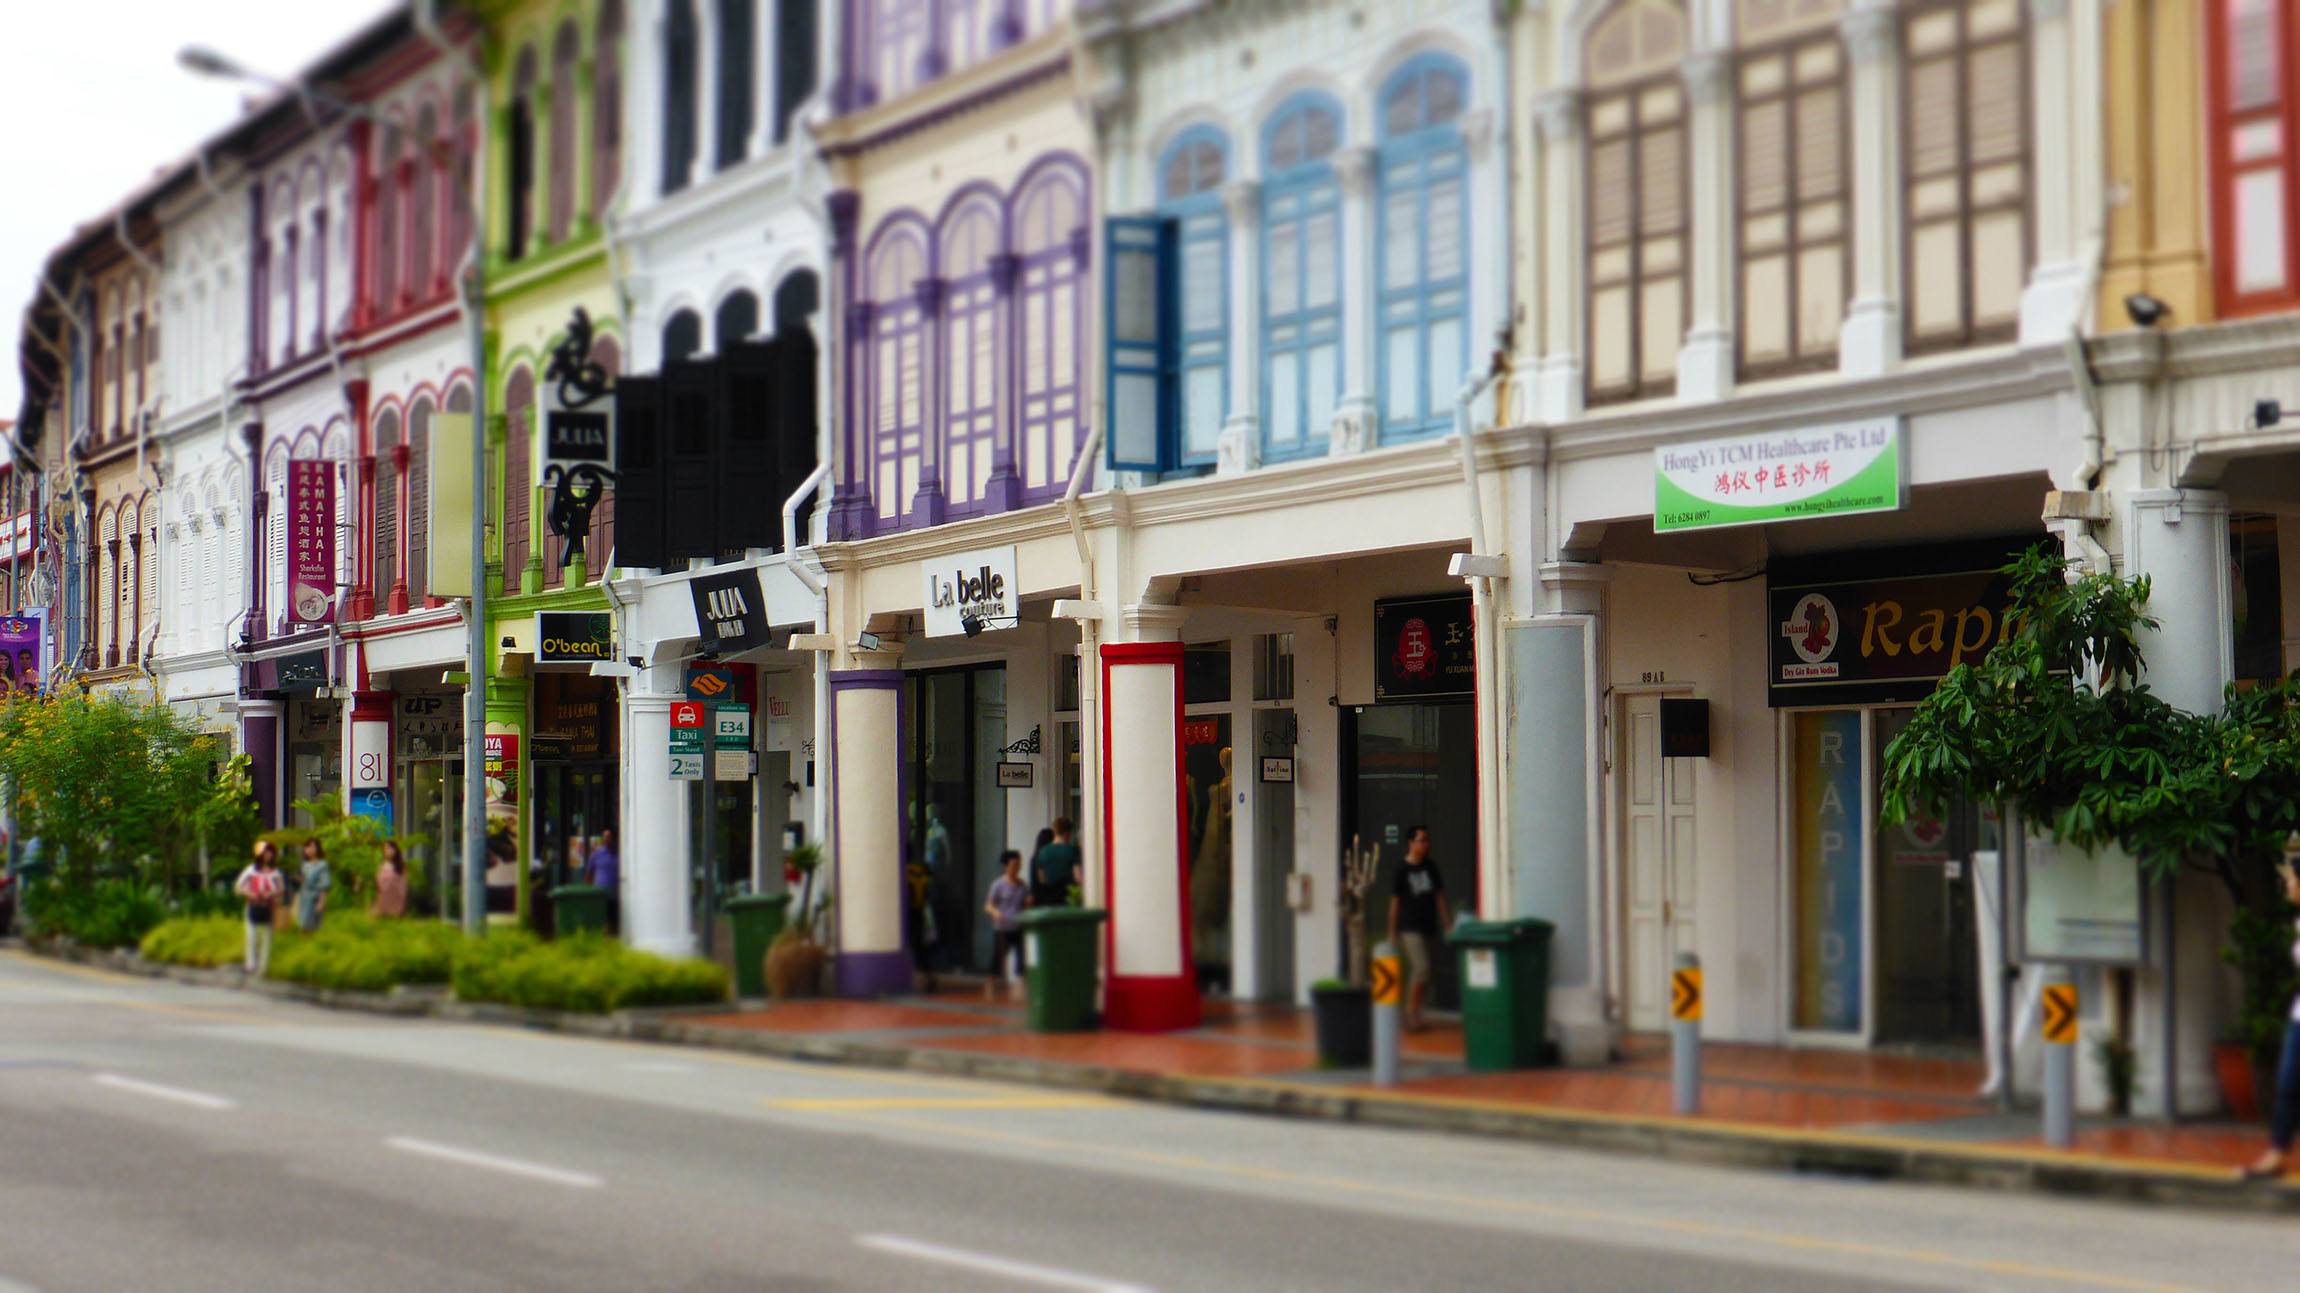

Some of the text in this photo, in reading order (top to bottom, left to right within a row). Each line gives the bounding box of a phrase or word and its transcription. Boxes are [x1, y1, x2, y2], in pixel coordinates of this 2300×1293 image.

[555, 427, 604, 446] JULIA
[1664, 427, 1885, 472] HongYi TCM Healthcare Pte Ltd
[1664, 514, 1676, 524] Tel:
[931, 566, 1004, 608] La belle
[706, 586, 748, 620] JULIA
[1784, 623, 1808, 634] Island
[543, 638, 602, 657] O'bean
[676, 730, 697, 740] Taxi
[720, 721, 744, 733] E34
[360, 752, 383, 781] 81
[671, 759, 683, 775] 2
[684, 769, 699, 777] Only
[1818, 730, 1846, 1020] RAPIDS
